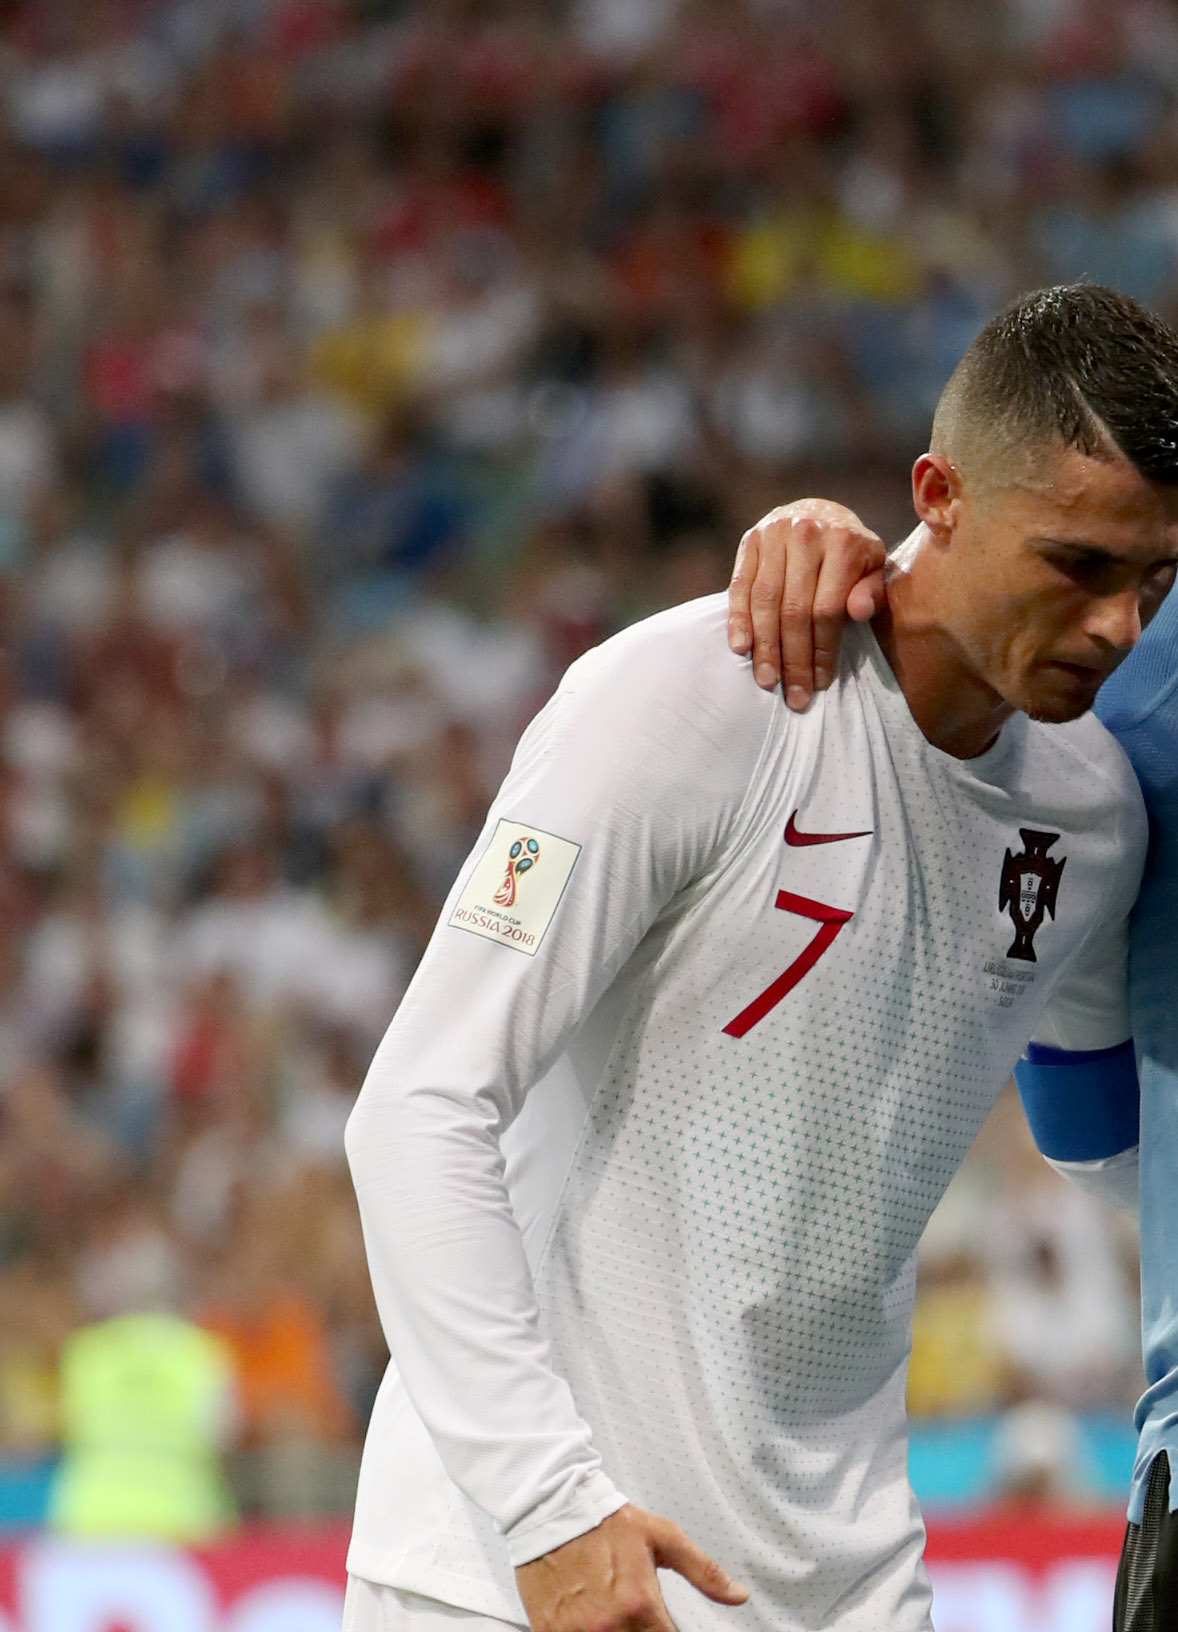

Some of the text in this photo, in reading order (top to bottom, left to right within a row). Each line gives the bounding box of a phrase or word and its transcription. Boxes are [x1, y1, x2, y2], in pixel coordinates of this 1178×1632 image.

[454, 908, 536, 947] RUSSIA 2018
[474, 905, 522, 926] FIFA WORLD CUP
[721, 889, 854, 1039] 7
